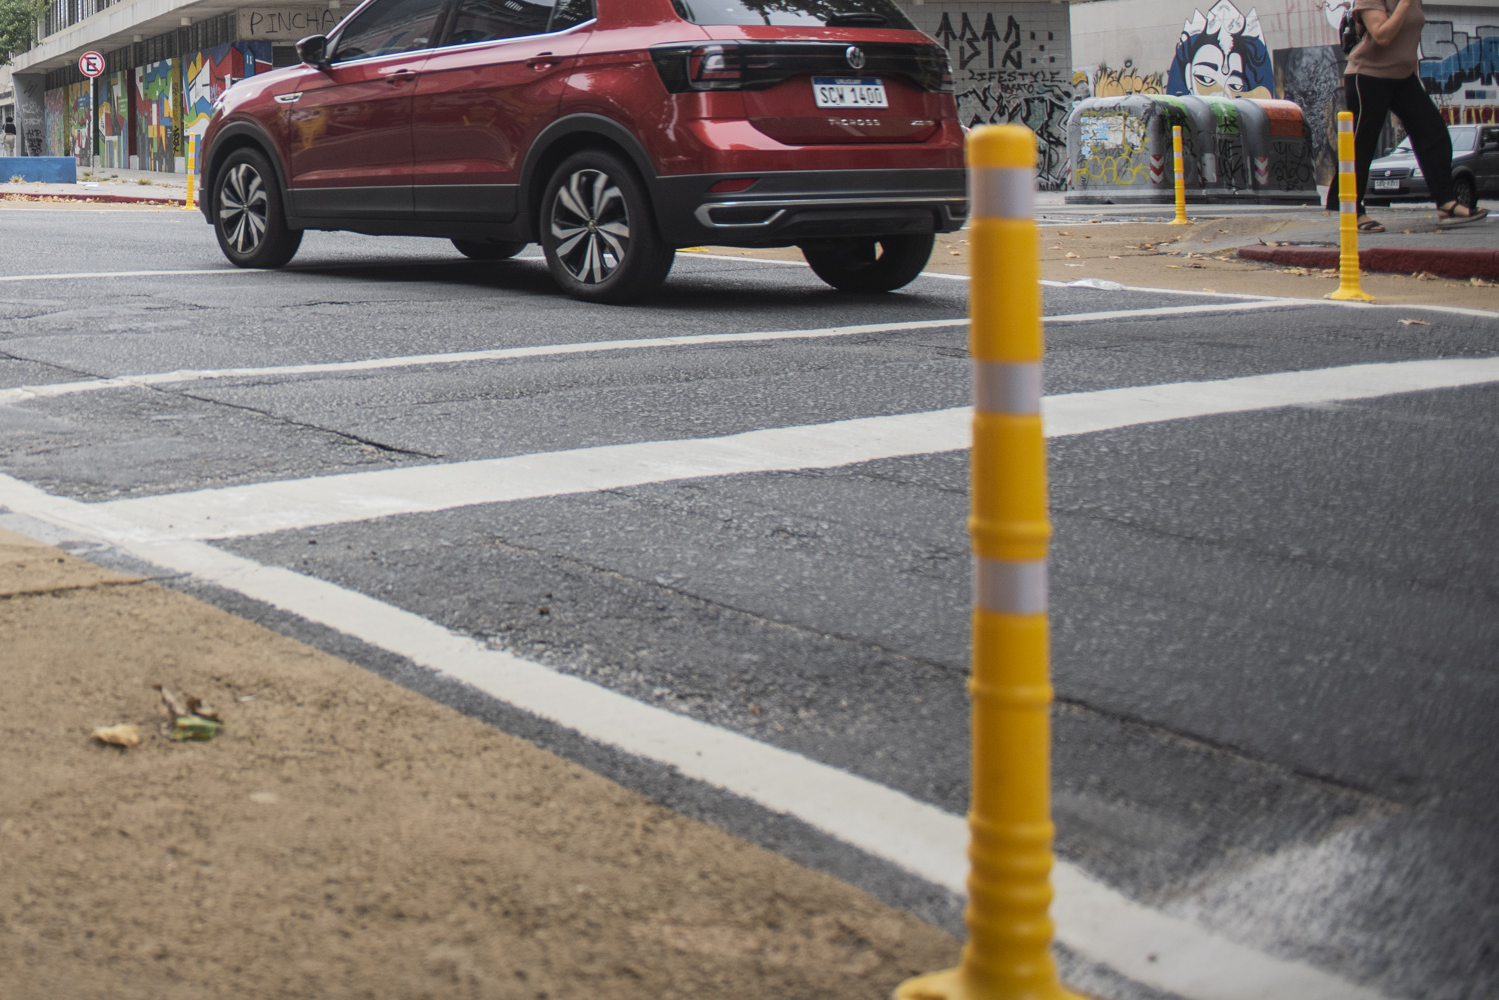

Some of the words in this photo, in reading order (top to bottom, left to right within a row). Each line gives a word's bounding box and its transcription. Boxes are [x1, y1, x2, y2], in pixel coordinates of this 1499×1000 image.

[86, 56, 98, 72] E
[820, 87, 846, 104] SCW
[850, 87, 883, 104] 1400
[827, 118, 881, 126] T-CROSS
